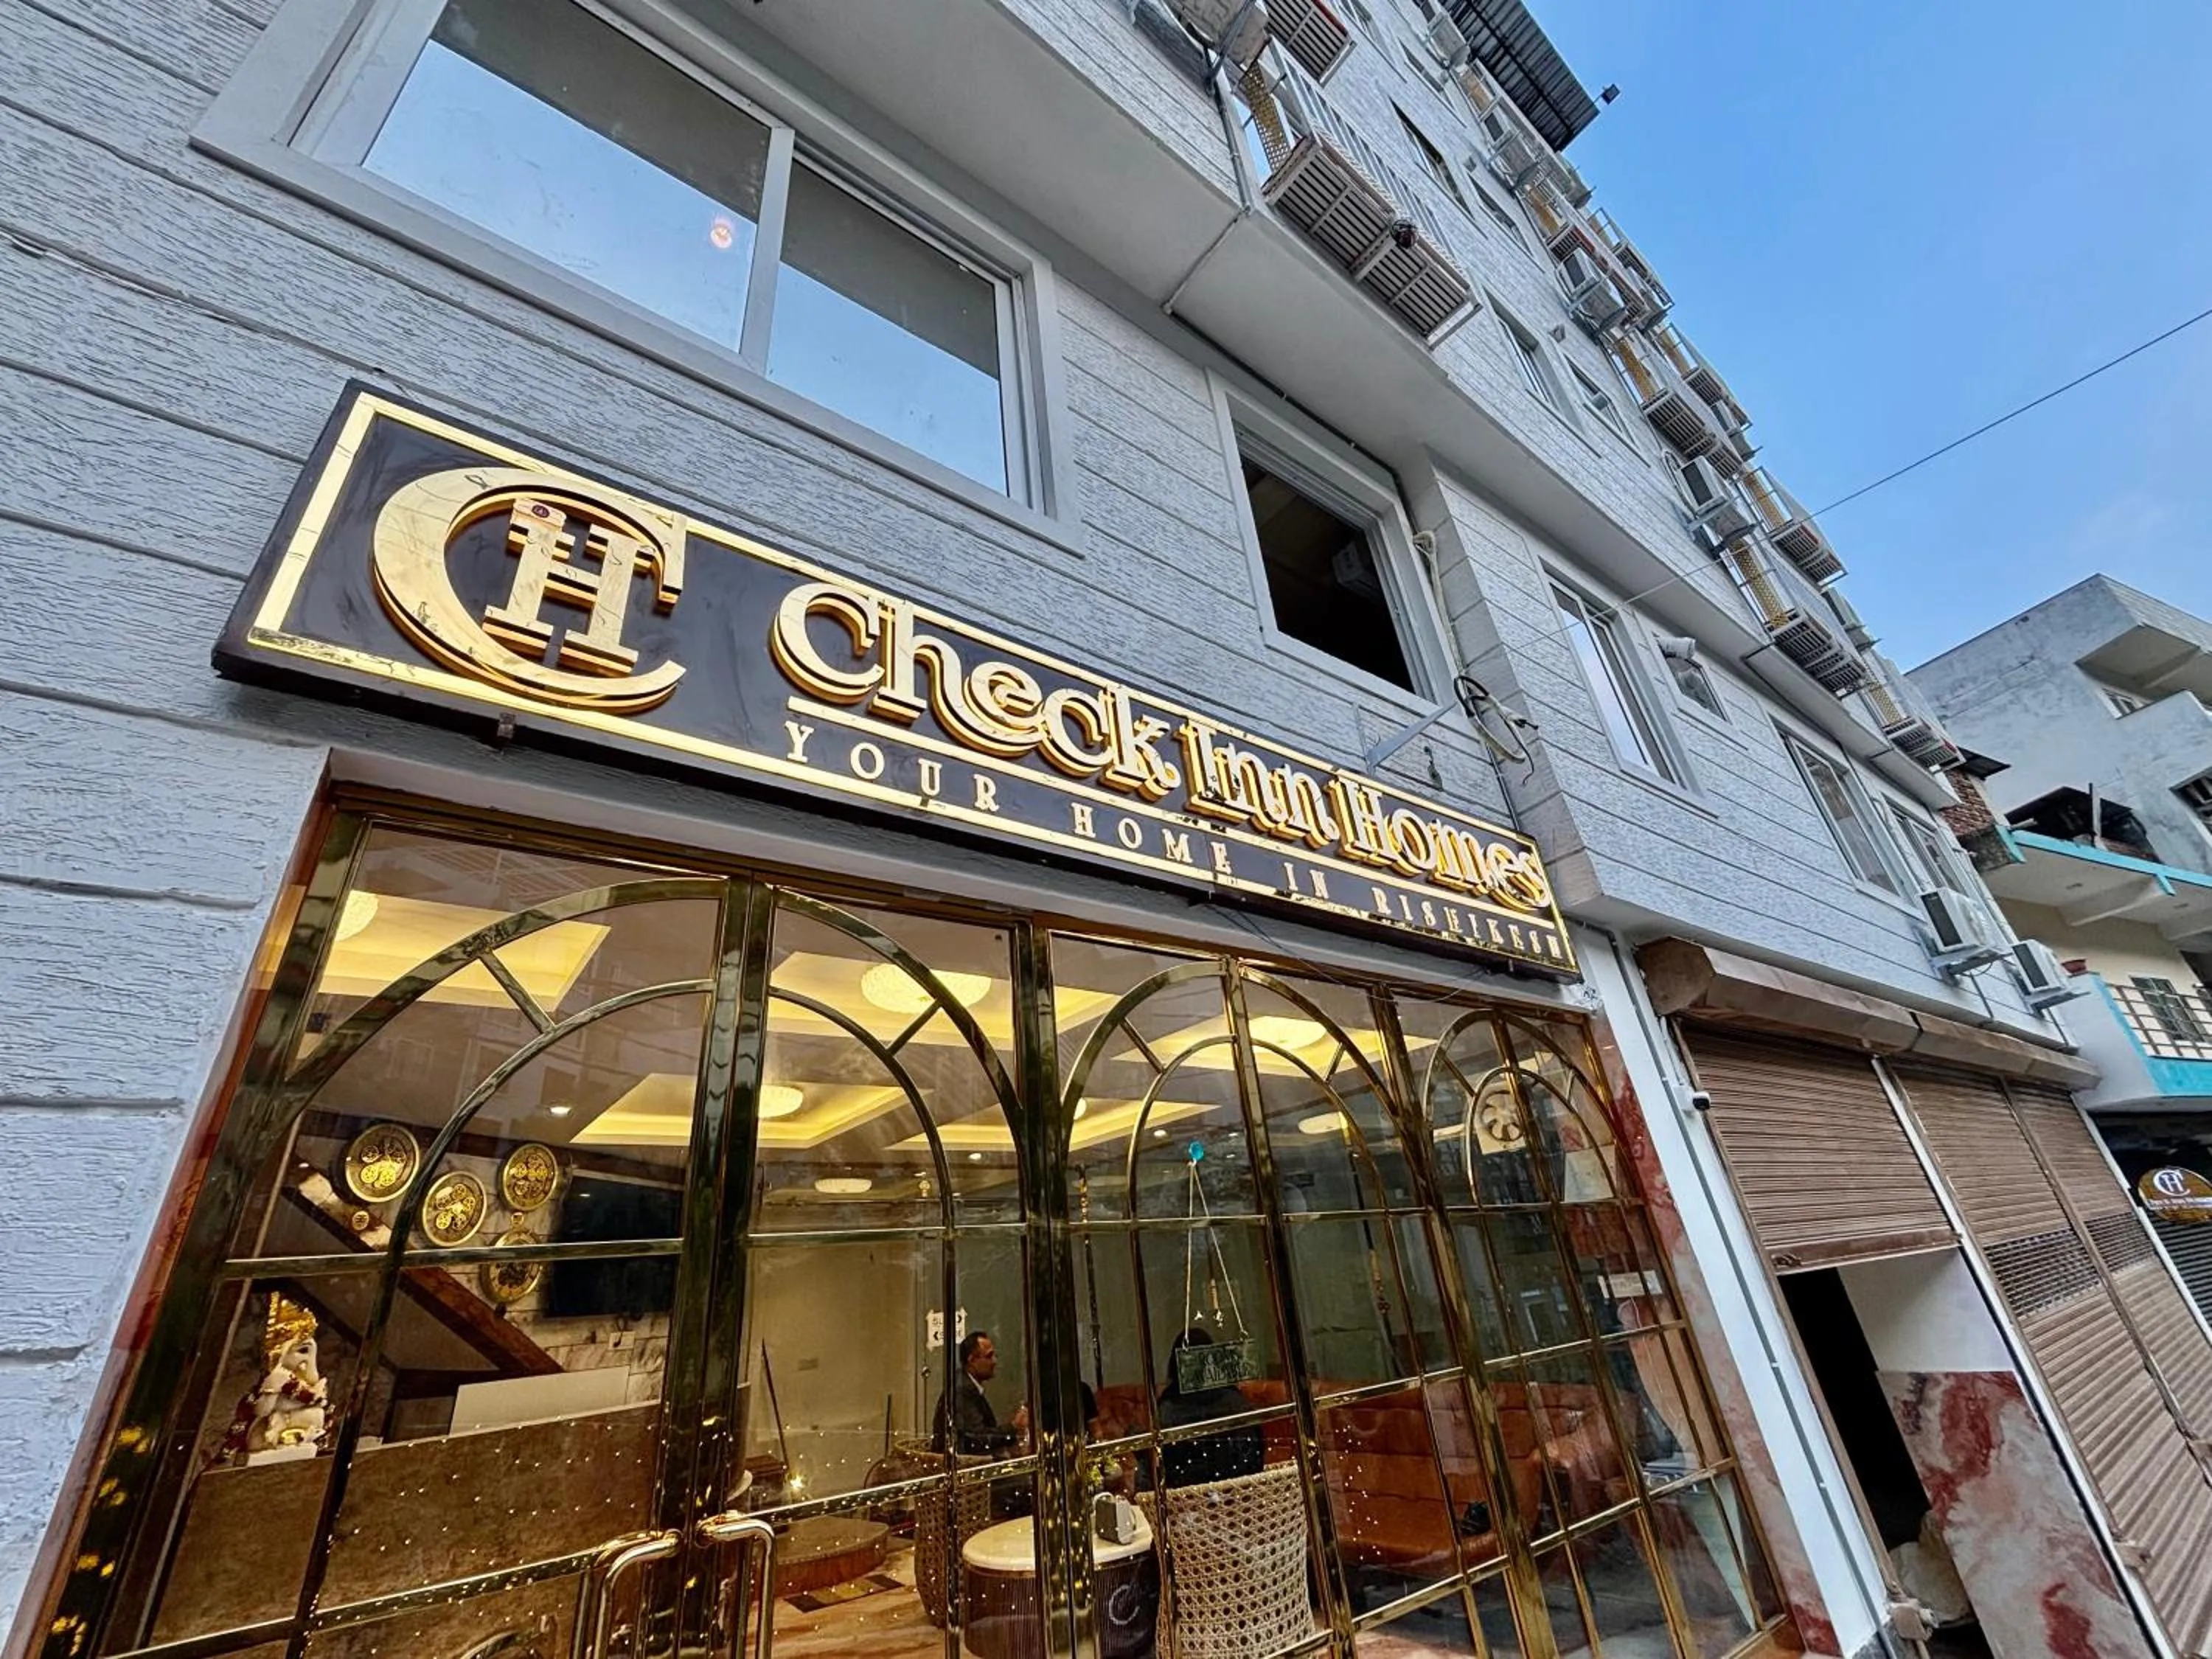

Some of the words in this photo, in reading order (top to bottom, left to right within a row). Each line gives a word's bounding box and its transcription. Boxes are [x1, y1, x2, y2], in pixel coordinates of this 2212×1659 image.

[770, 582, 1180, 801] Check
[1178, 715, 1340, 849] Inn
[1325, 778, 1551, 912] Homes
[784, 720, 1000, 813] YOUR
[1071, 801, 1232, 874] HOME
[1284, 862, 1329, 900] IN
[1371, 887, 1562, 959] RISHIKESH
